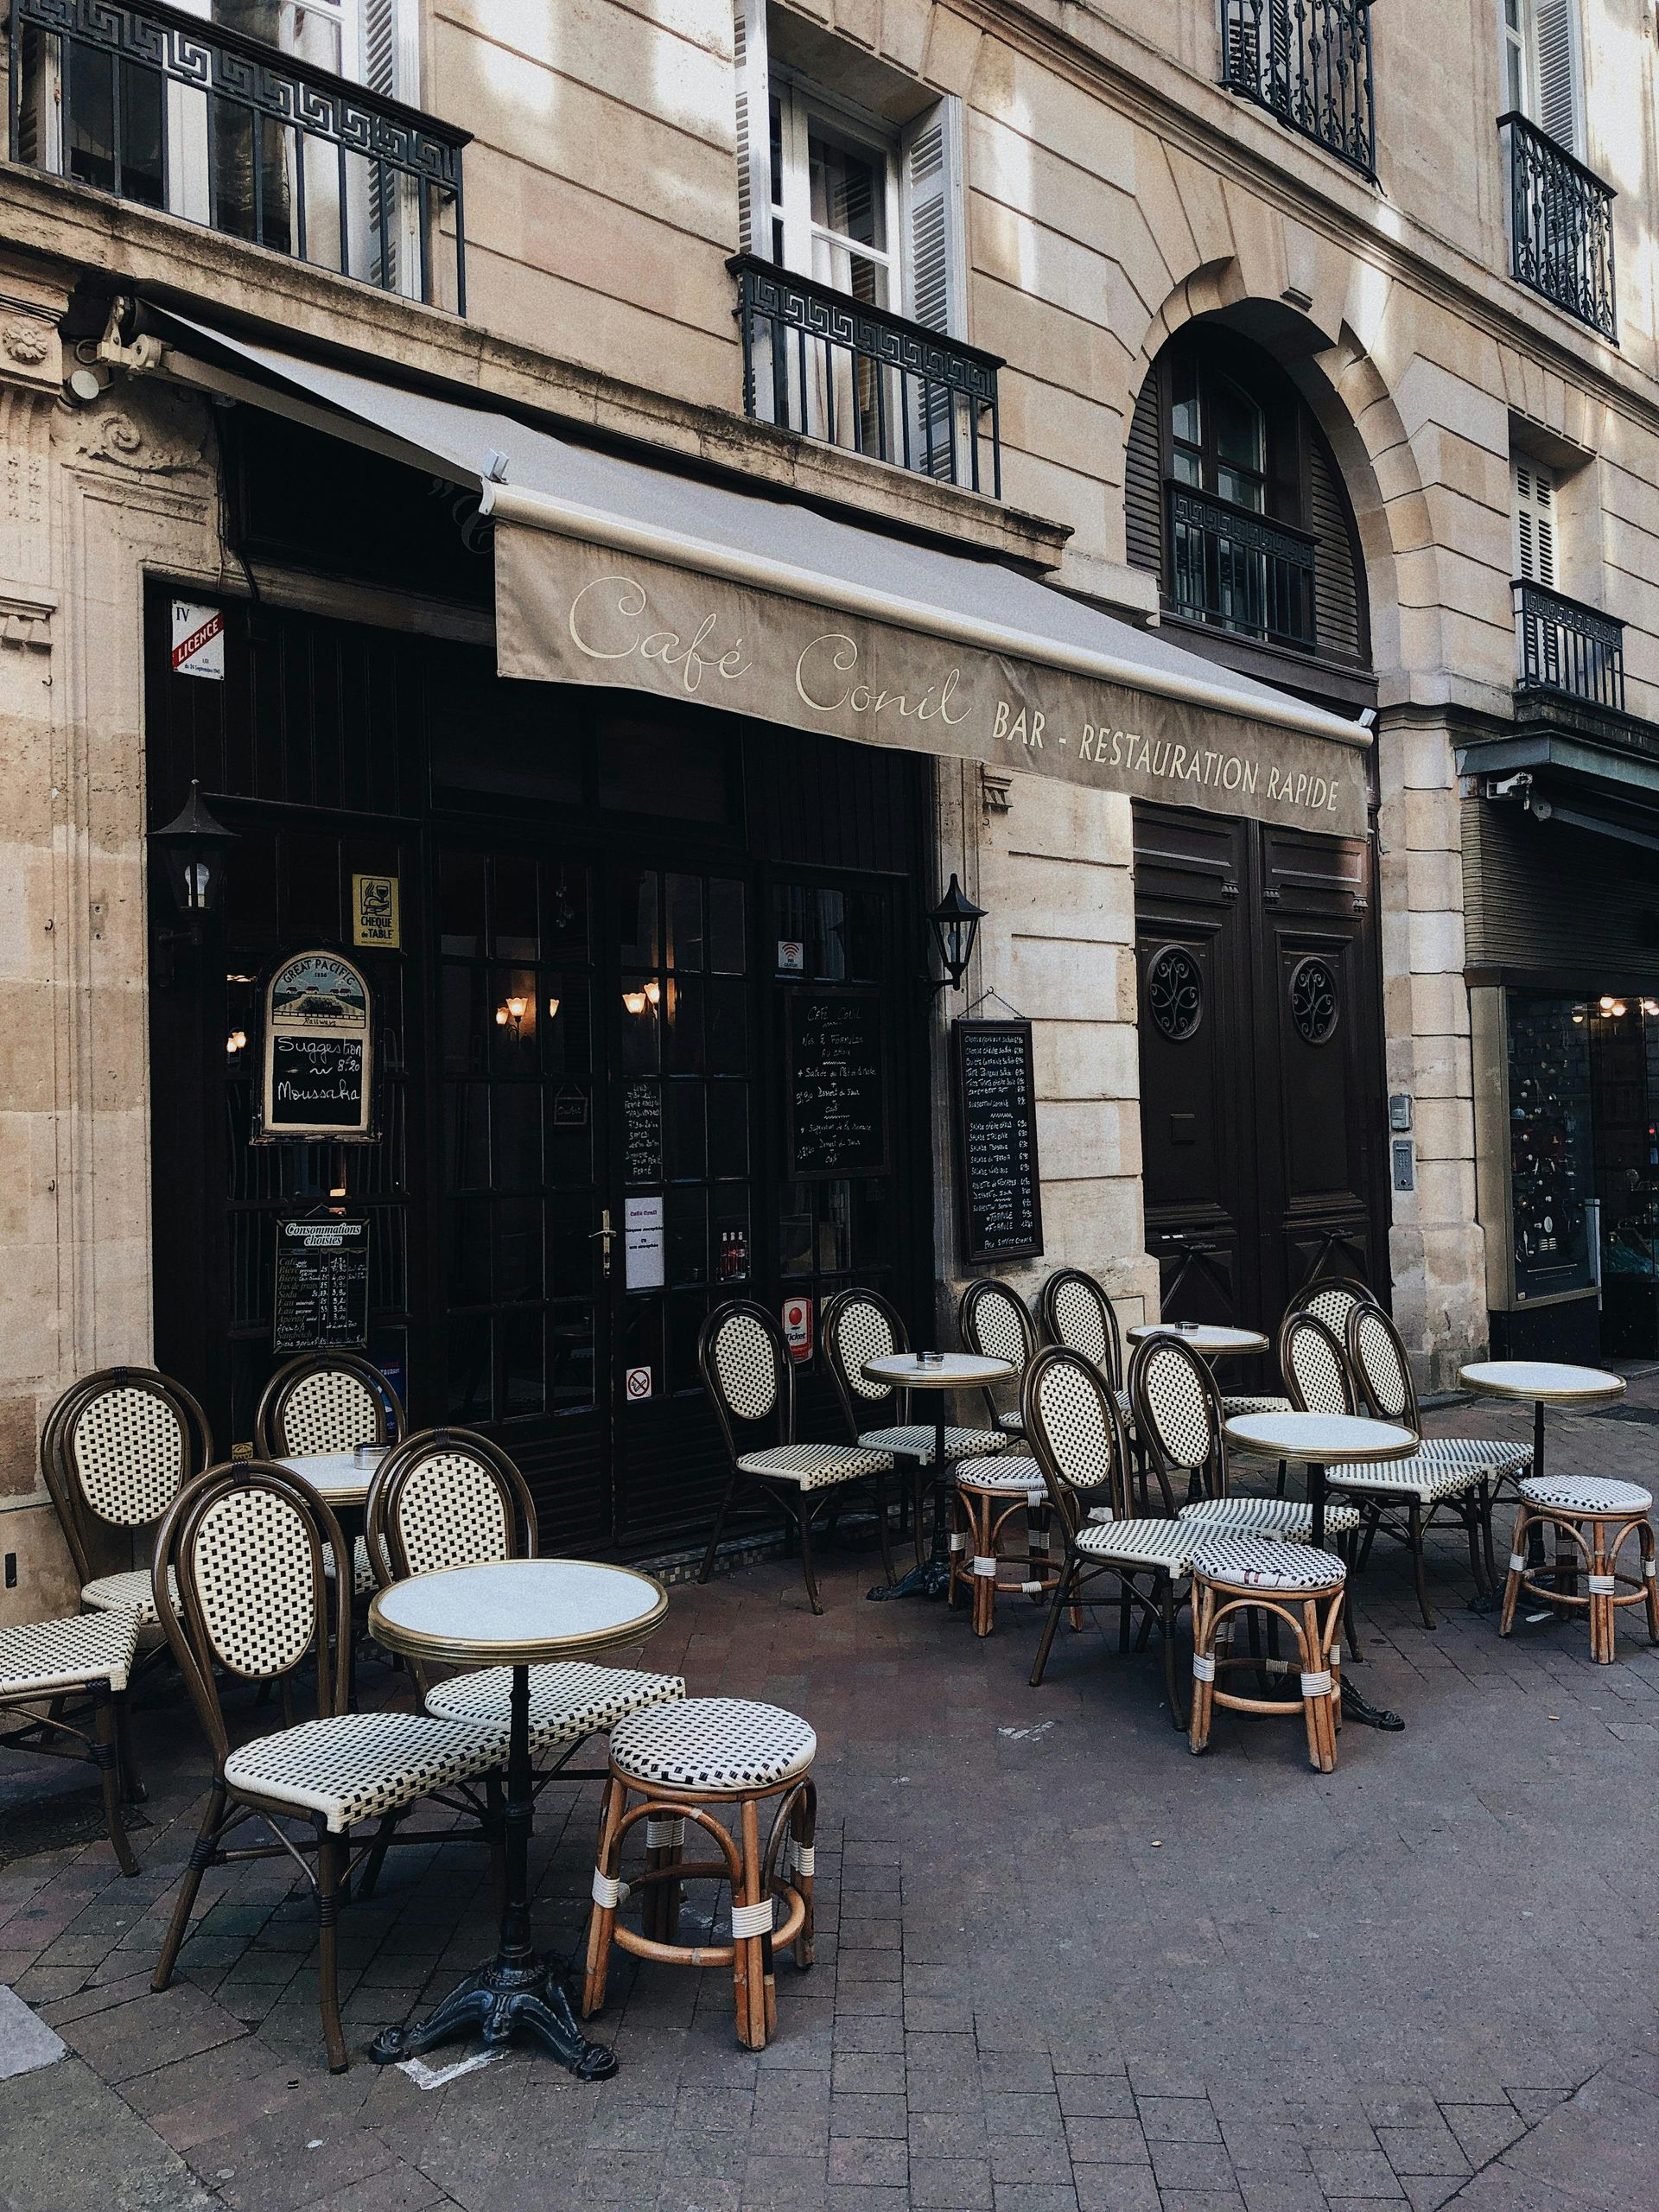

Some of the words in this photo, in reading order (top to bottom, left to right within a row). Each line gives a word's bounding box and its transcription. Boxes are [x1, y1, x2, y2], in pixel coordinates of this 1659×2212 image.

[176, 607, 189, 621] IV
[178, 619, 219, 663] LICENCE
[569, 576, 753, 692] Café
[795, 634, 971, 725] Conil
[992, 701, 1046, 749] BAR
[1078, 723, 1259, 795] RESTAURATION
[1267, 766, 1340, 812] RAPIDE
[368, 929, 393, 939] TABLE
[283, 959, 312, 983] GREAT
[315, 958, 355, 985] PACIFIC
[277, 1036, 361, 1065] Suggestion
[277, 1078, 361, 1101] Moussaka
[285, 1223, 362, 1236] Consommations
[303, 1235, 343, 1246] choisies
